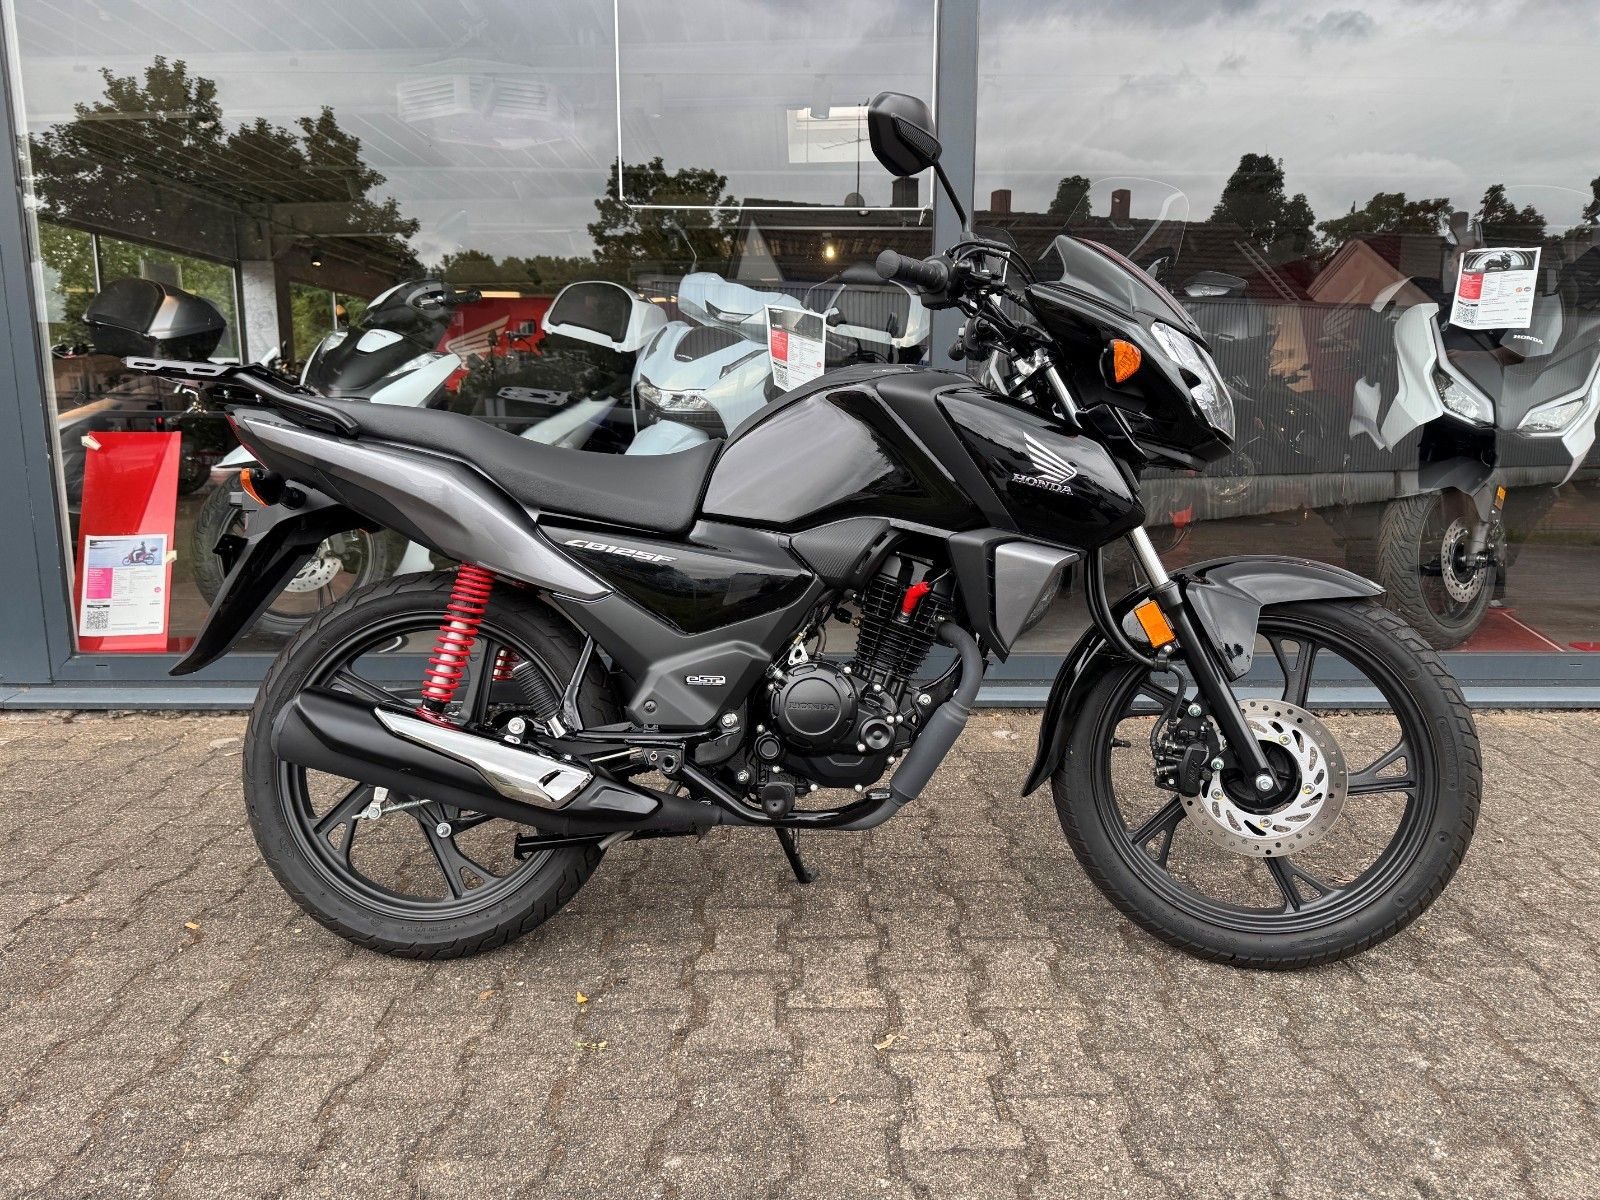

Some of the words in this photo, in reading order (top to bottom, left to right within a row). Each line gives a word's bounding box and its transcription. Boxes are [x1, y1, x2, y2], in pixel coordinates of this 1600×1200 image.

[1512, 334, 1544, 345] HONDA
[1011, 472, 1074, 496] HONDA
[564, 539, 679, 562] CB125F
[788, 701, 838, 711] HONDA
